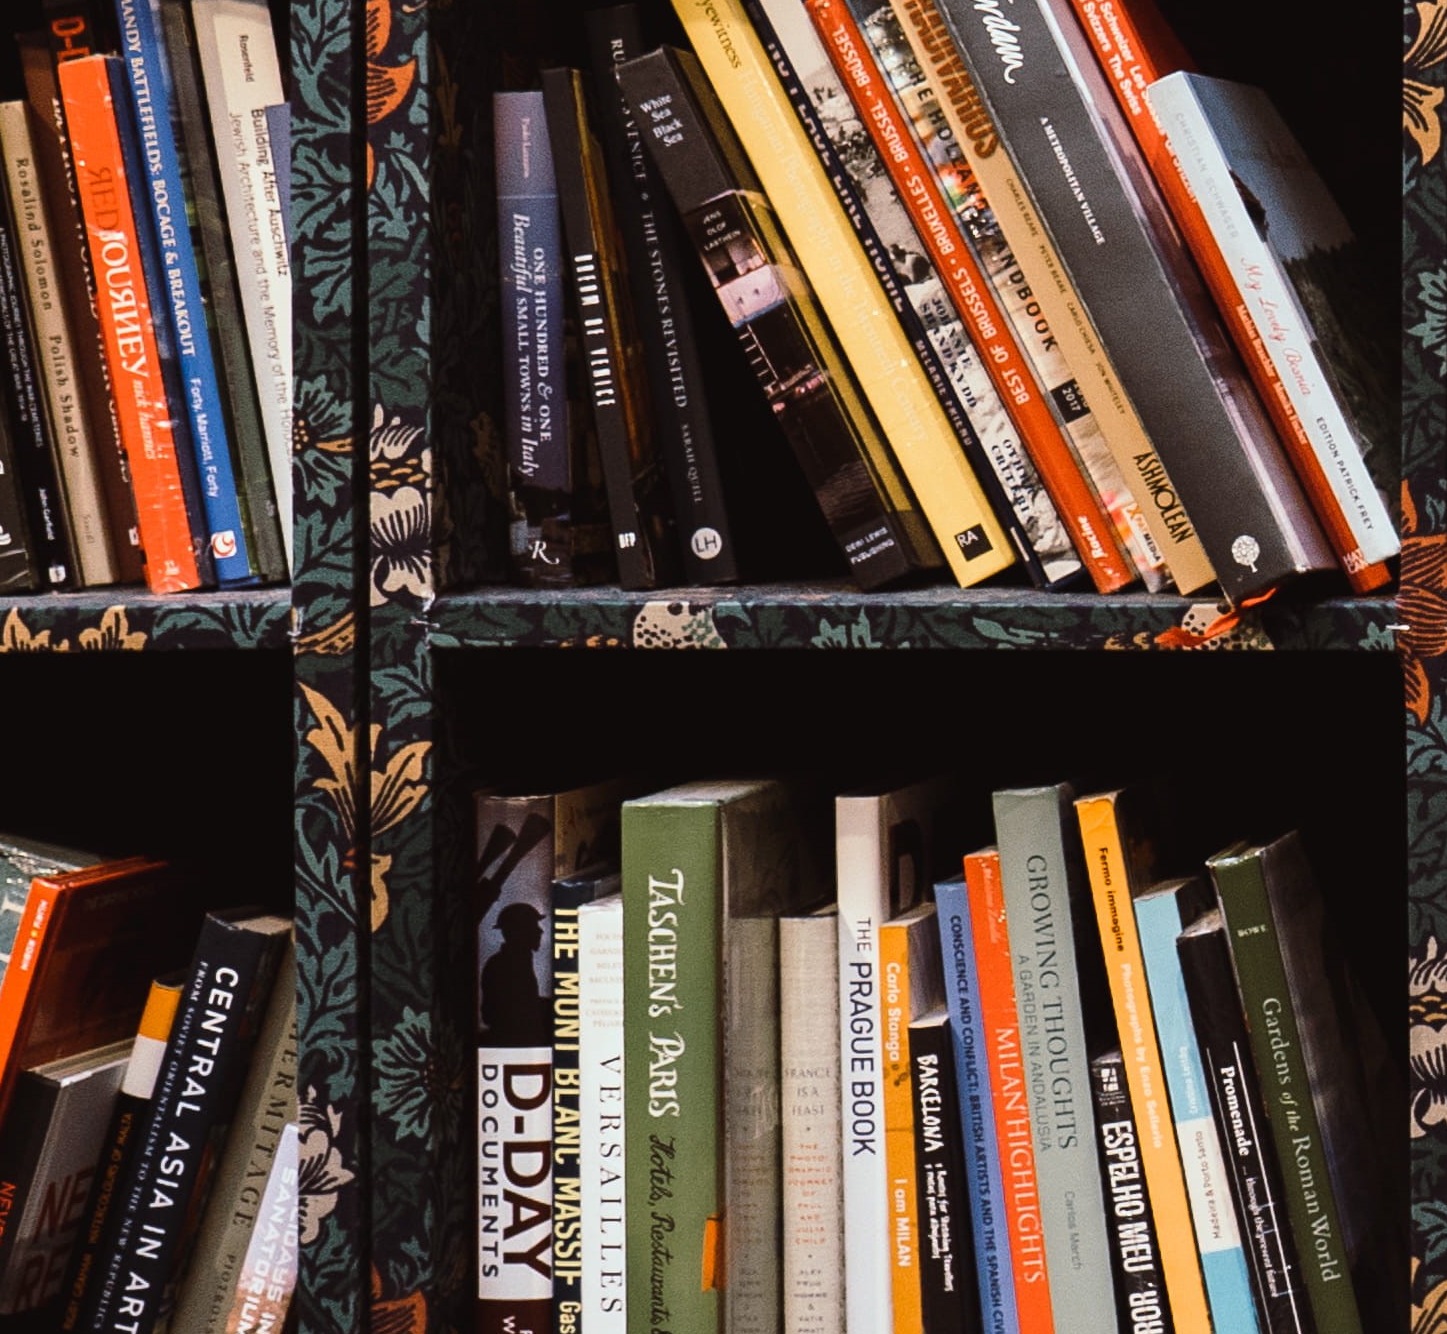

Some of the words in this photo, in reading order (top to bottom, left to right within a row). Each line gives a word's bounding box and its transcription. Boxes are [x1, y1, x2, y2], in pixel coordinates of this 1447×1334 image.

[505, 213, 531, 292] Beautiful
[533, 247, 546, 284] ONE
[516, 296, 528, 349] SMALL
[534, 290, 549, 377] HUNDRED
[518, 354, 529, 411] TOWNS
[537, 382, 552, 399] &
[518, 437, 538, 477] Italy
[520, 415, 534, 431] in
[538, 404, 552, 441] ONE
[1132, 447, 1195, 545] ASHMOLEAN
[856, 917, 871, 950] THE
[1024, 853, 1060, 990] GROWING
[174, 966, 239, 1117] CENTRAL
[849, 961, 873, 1072] PRAGUE
[1260, 995, 1296, 1085] Gardens
[915, 1053, 944, 1152] BARCELONA
[1041, 995, 1078, 1151] THOUGHTS
[1219, 1064, 1252, 1157] Promenade
[1278, 1090, 1298, 1109] of
[851, 1080, 875, 1155] BOOK
[1284, 1109, 1303, 1132] the
[148, 1130, 190, 1208] ASIA
[481, 1063, 498, 1277] DOCUMENTS
[501, 1063, 553, 1280] D-DAY
[599, 1055, 622, 1312] VERSAILLES
[1101, 1119, 1145, 1217] ESPELHO
[1290, 1134, 1324, 1214] Roman
[134, 1223, 166, 1259] IN
[1117, 1220, 1153, 1273] MEU
[1308, 1214, 1341, 1282] World
